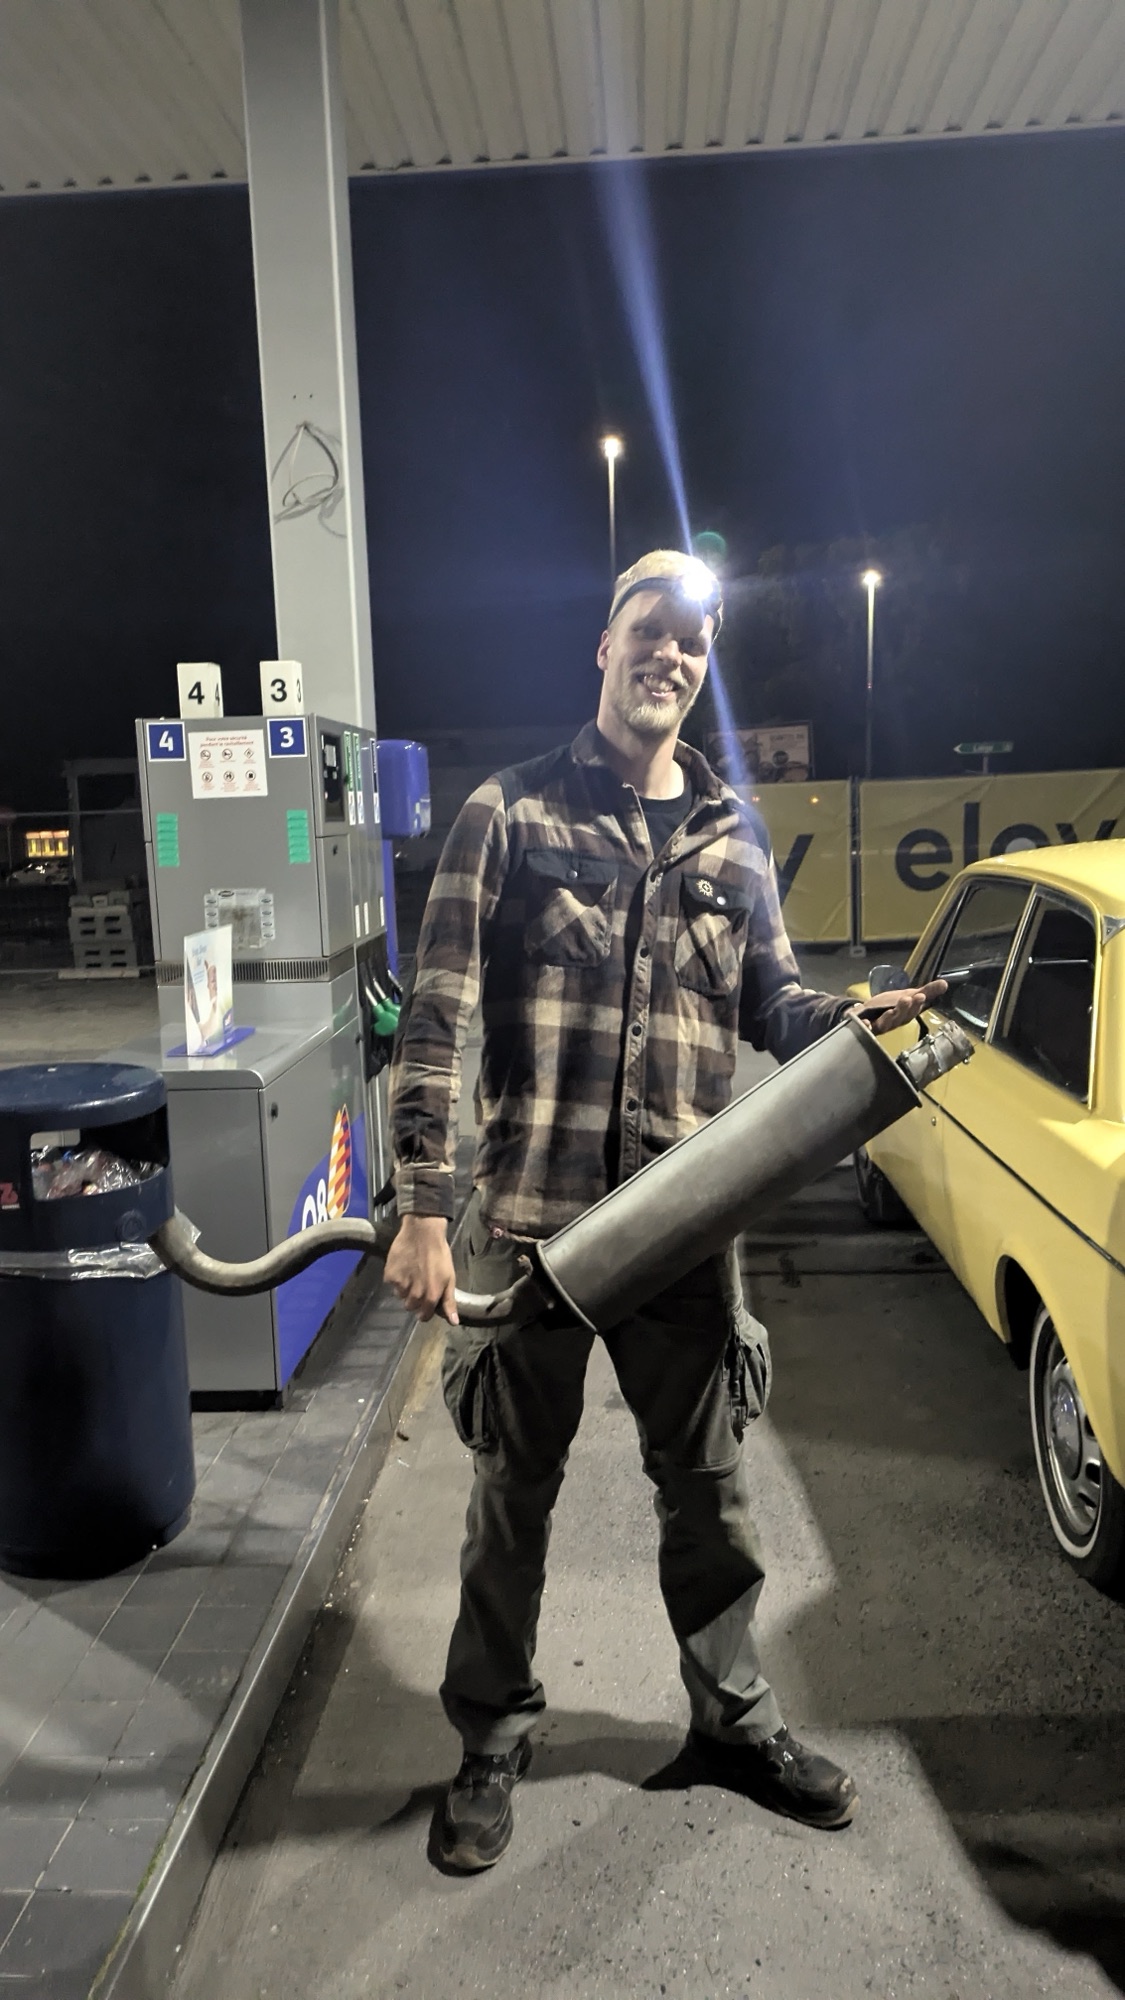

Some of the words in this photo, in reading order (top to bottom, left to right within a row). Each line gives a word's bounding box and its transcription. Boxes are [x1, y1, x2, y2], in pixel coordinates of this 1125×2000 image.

[188, 681, 205, 705] 4
[270, 678, 288, 703] 3
[158, 730, 174, 752] 4
[279, 726, 295, 749] 3
